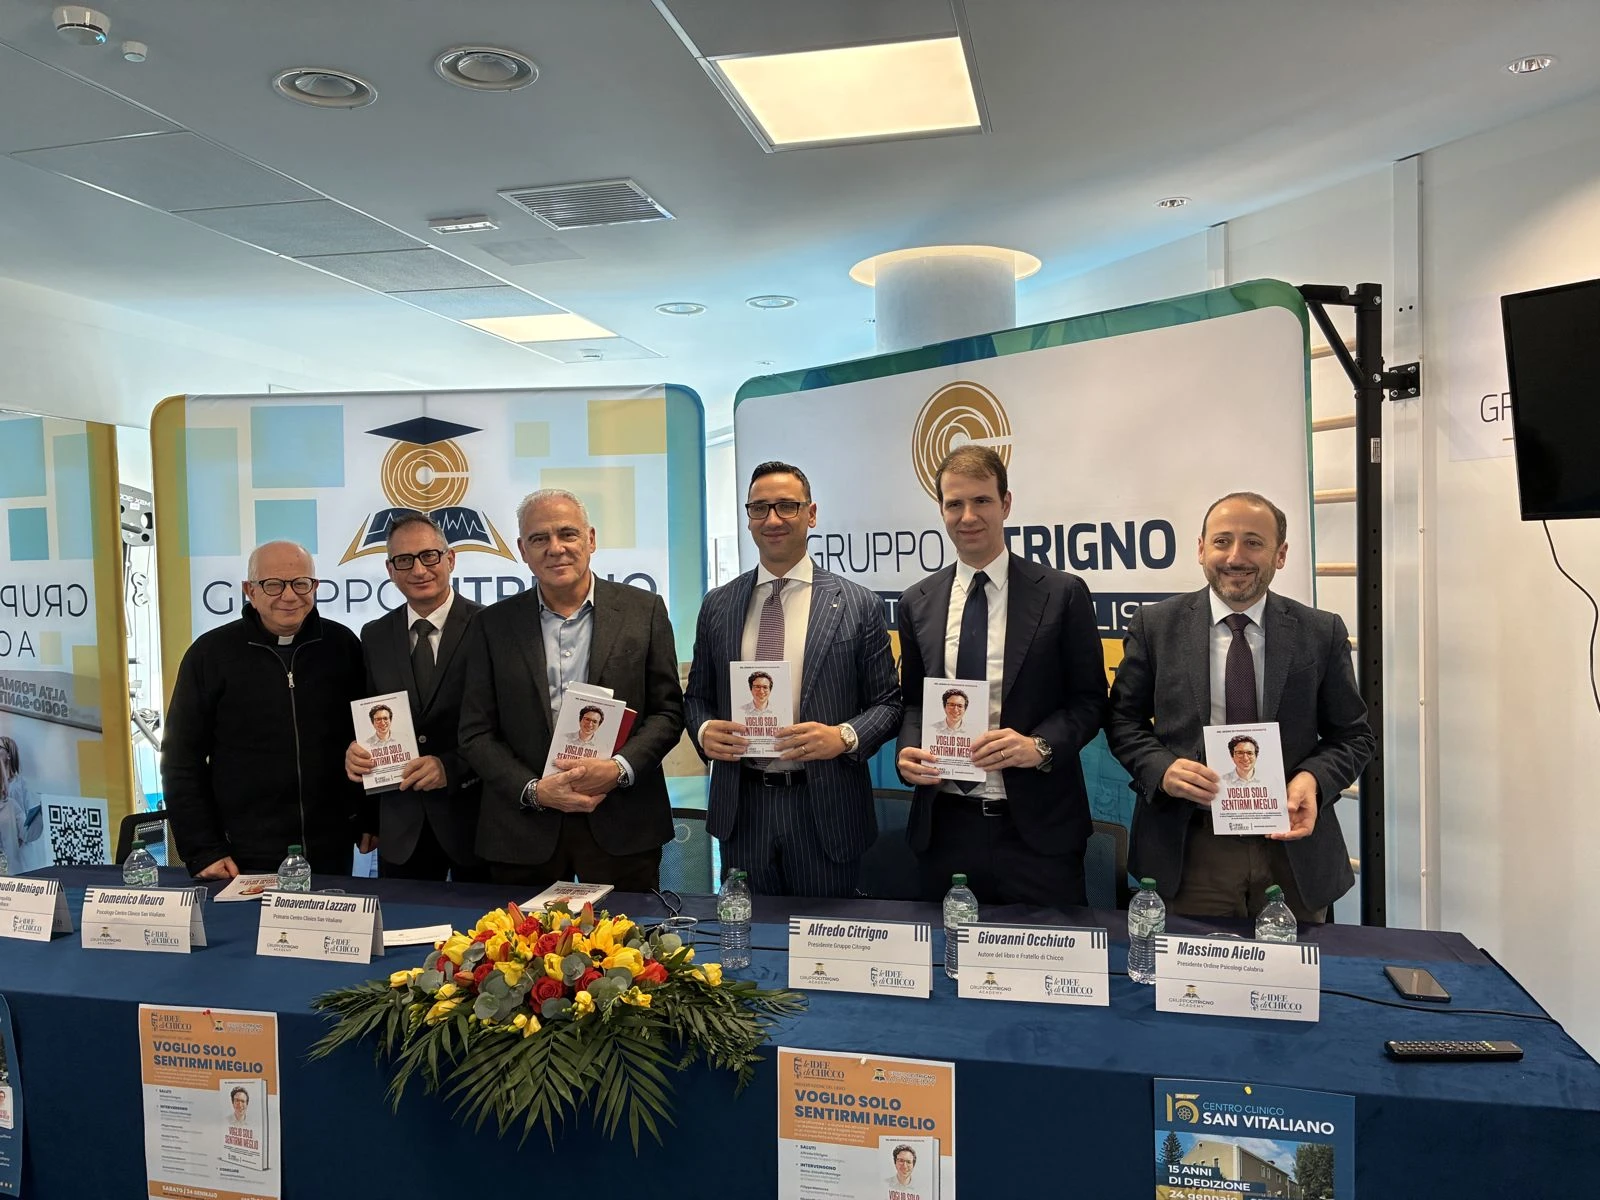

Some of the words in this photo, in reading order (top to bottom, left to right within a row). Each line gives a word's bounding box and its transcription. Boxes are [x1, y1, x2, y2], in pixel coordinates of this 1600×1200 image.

[745, 717, 763, 726] VOGLIO
[764, 717, 777, 726] SOLO
[936, 736, 955, 746] VOGLIO
[957, 738, 970, 747] SOLO
[371, 746, 388, 758] VOGLIO
[389, 744, 402, 754] SOLO
[565, 745, 584, 756] VOGLIO
[930, 745, 955, 757] SENTIRMI
[392, 752, 410, 764] MEGLIO
[1227, 788, 1250, 799] VOGLIO
[1252, 787, 1267, 798] SOLO
[1222, 800, 1252, 810] SENTIRMI
[1254, 799, 1278, 810] MEGLIO
[16, 882, 44, 896] Maniago
[98, 892, 137, 905] Domenico
[138, 894, 164, 906] Mauro
[275, 897, 324, 910] Bonaventura
[325, 900, 356, 912] Lazzaro
[808, 923, 845, 937] Alfredo
[847, 925, 888, 941] Citrigno
[978, 931, 1025, 945] Giovanni
[1027, 934, 1075, 948] Occhiuto
[1177, 942, 1229, 958] Massimo
[1231, 946, 1265, 961] Aiello
[1220, 963, 1242, 971] Psicologi
[886, 978, 915, 986] CHICCO
[1060, 978, 1079, 986] IDEE
[1062, 986, 1093, 994] CHICCO
[1267, 994, 1287, 1002] IDEE
[1268, 1002, 1302, 1011] CHICCO
[153, 1041, 200, 1054] VOGLIO
[203, 1044, 236, 1057] SOLO
[154, 1055, 213, 1069] SENTIRMI
[215, 1060, 263, 1073] MEGLIO
[811, 1061, 830, 1069] IDEE
[811, 1069, 844, 1078] CHICCO
[795, 1089, 855, 1106] VOGLIO
[859, 1095, 901, 1111] SOLO
[1203, 1102, 1242, 1112] CENTRO
[1245, 1105, 1284, 1116] CLINICO
[794, 1105, 870, 1124] SENTIRMI
[874, 1113, 935, 1130] MEGLIO
[1203, 1112, 1237, 1126] SAN
[1245, 1116, 1335, 1135] VITALIANO
[1168, 1165, 1179, 1173] 15
[1182, 1167, 1212, 1176] ANNI
[1169, 1176, 1181, 1184] DI
[1185, 1178, 1250, 1191] DEDIZIONE
[1169, 1190, 1184, 1198] 24
